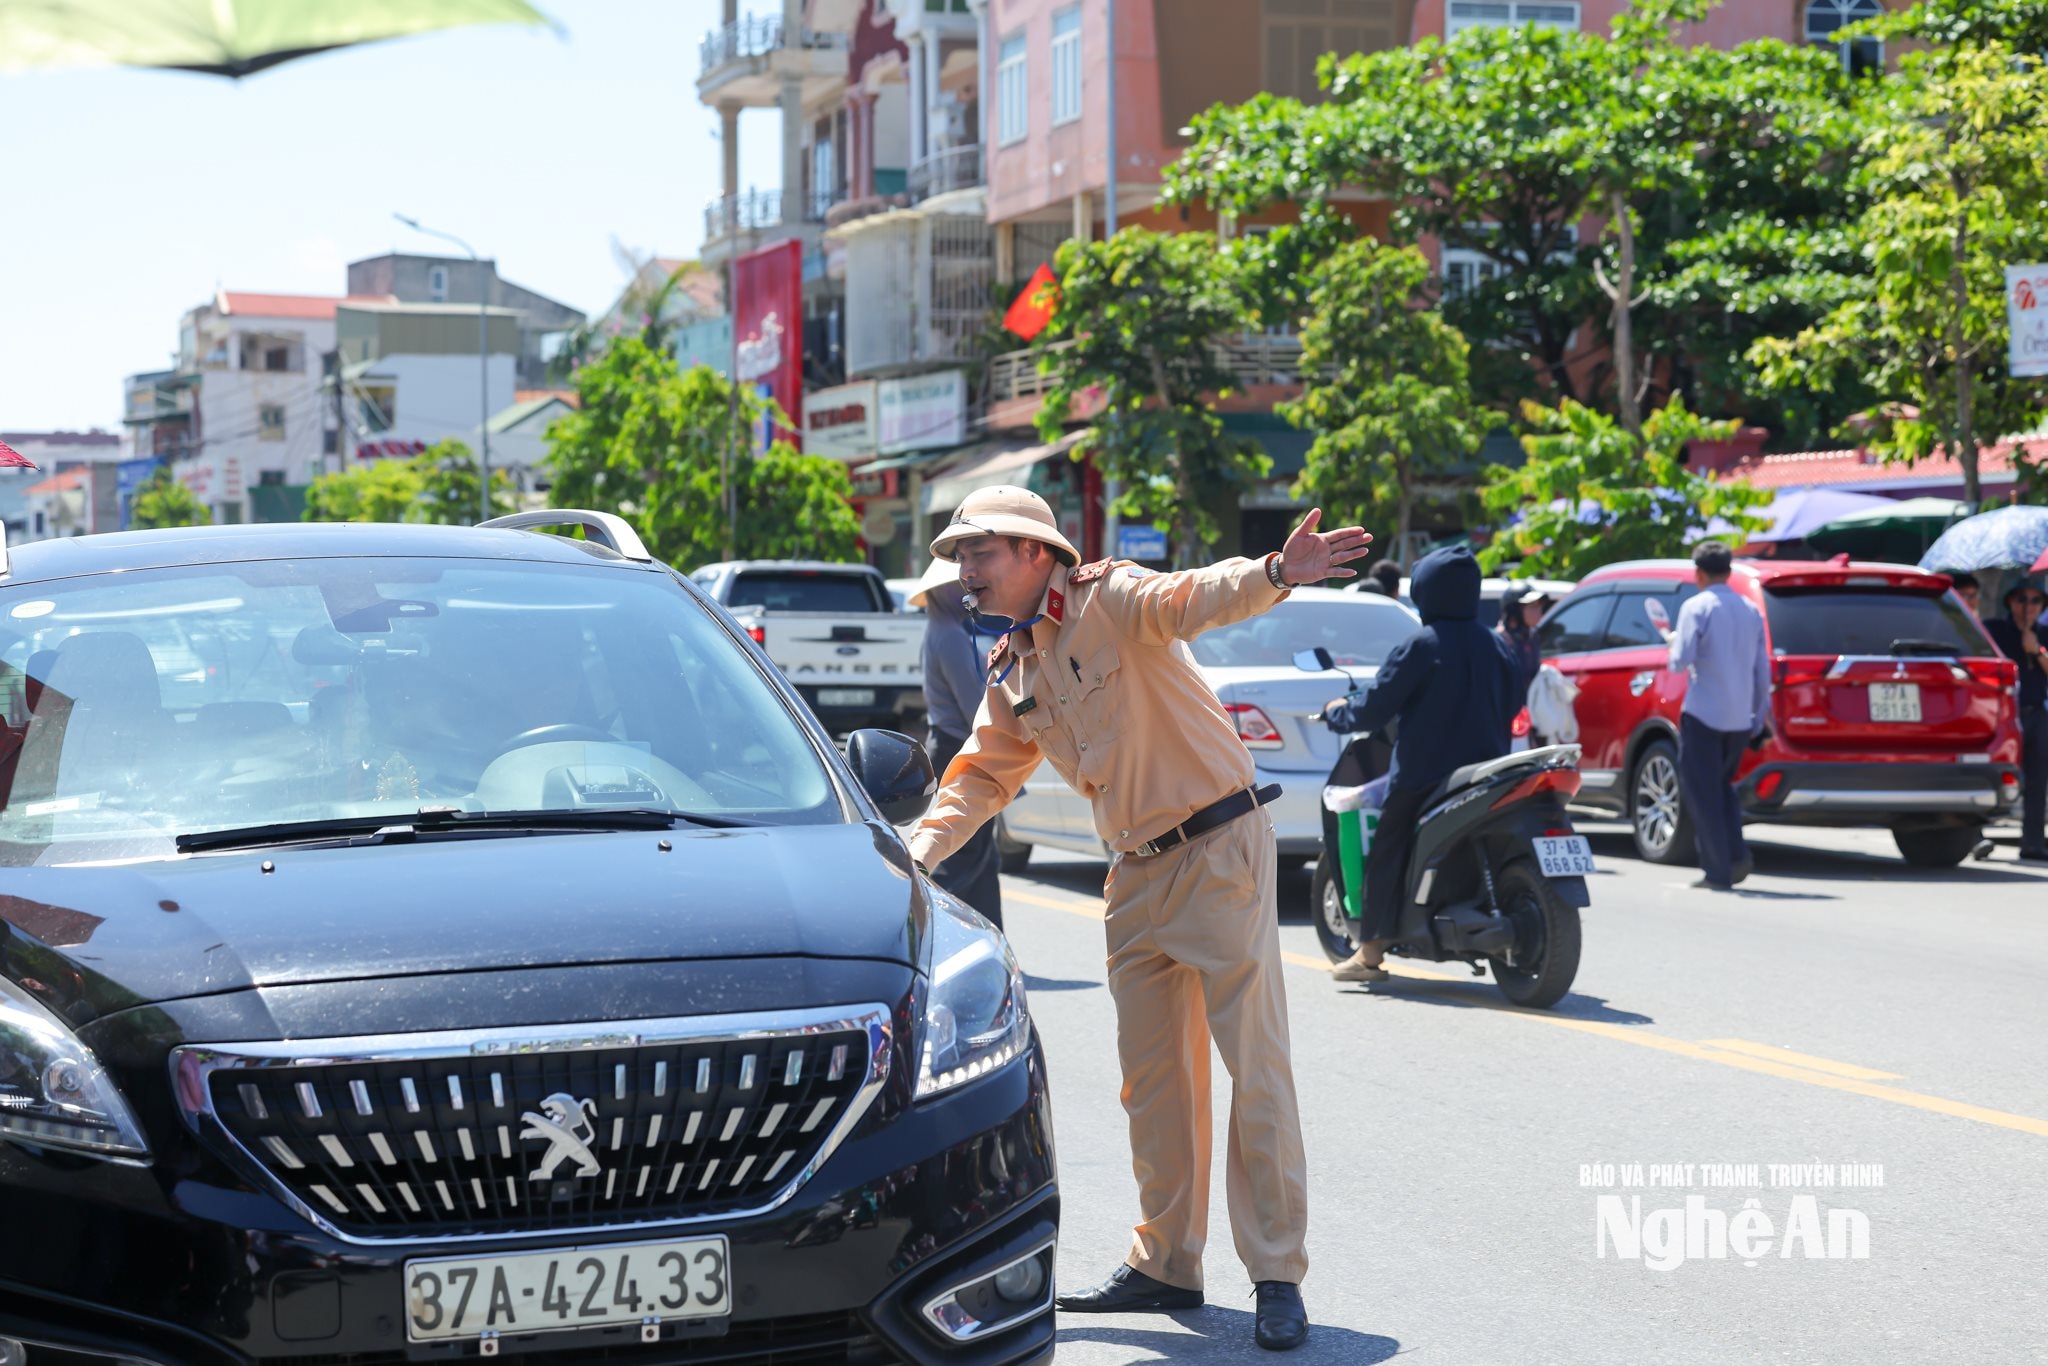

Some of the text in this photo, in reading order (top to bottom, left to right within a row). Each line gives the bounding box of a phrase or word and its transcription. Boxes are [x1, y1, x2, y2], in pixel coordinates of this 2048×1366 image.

[1542, 839, 1582, 855] 37-AB
[1543, 857, 1592, 873] 868.62
[411, 1248, 725, 1331] 37A-424.33
